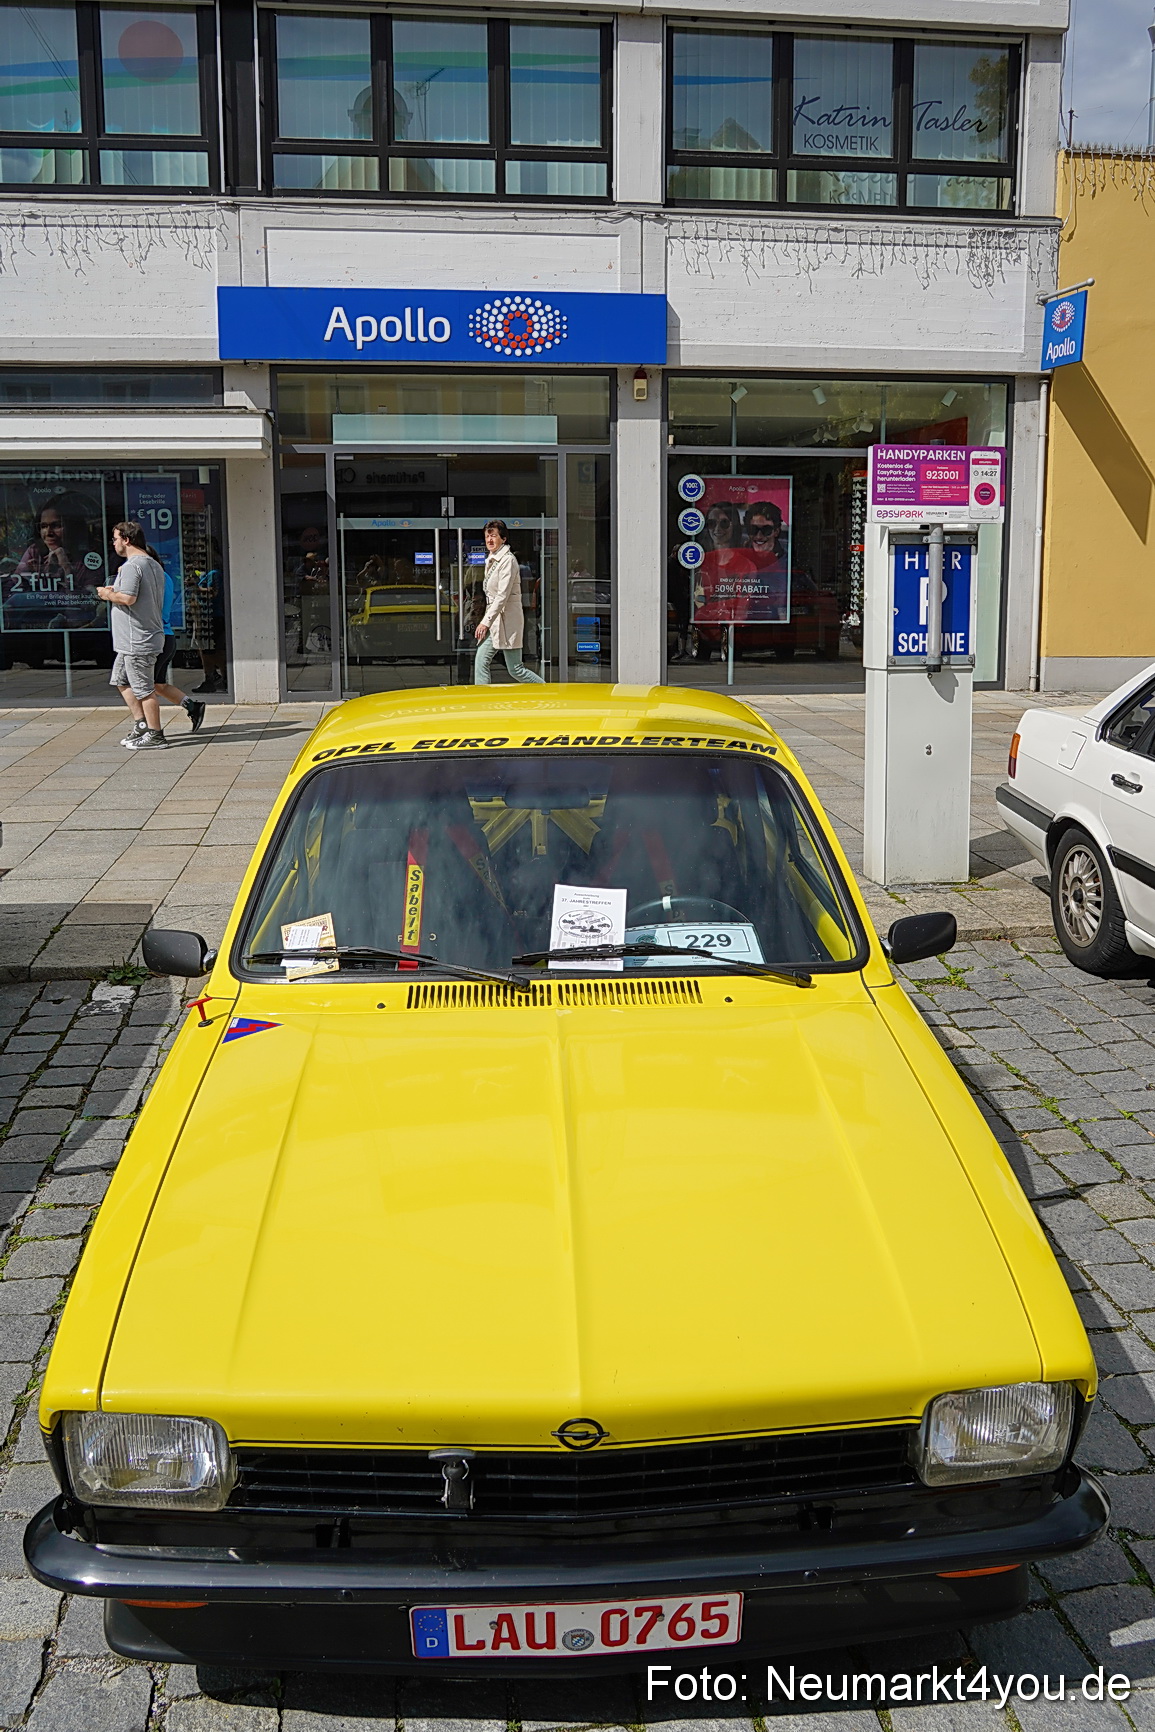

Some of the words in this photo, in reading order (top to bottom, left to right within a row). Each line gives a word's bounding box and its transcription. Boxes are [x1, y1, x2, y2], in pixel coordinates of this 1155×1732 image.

[793, 95, 892, 128] Katrin
[912, 100, 988, 133] Tasler
[803, 133, 880, 151] KOSMETIK
[323, 305, 451, 350] Apollo
[1046, 337, 1076, 363] Apollo
[877, 449, 966, 461] HANDYPARKEN
[926, 470, 959, 480] 923001
[372, 519, 396, 528] Apollo
[10, 574, 23, 592] 2
[30, 572, 62, 592] für
[66, 574, 74, 592] 1
[736, 585, 769, 594] RABATT
[312, 740, 396, 762] OPEL
[412, 736, 510, 750] EURO
[521, 734, 778, 756] HÄNDLERTEAM
[408, 870, 422, 941] Sabelt
[685, 934, 732, 948] 229
[454, 1612, 557, 1651] LAU
[600, 1600, 729, 1648] 0765
[426, 1638, 438, 1648] D
